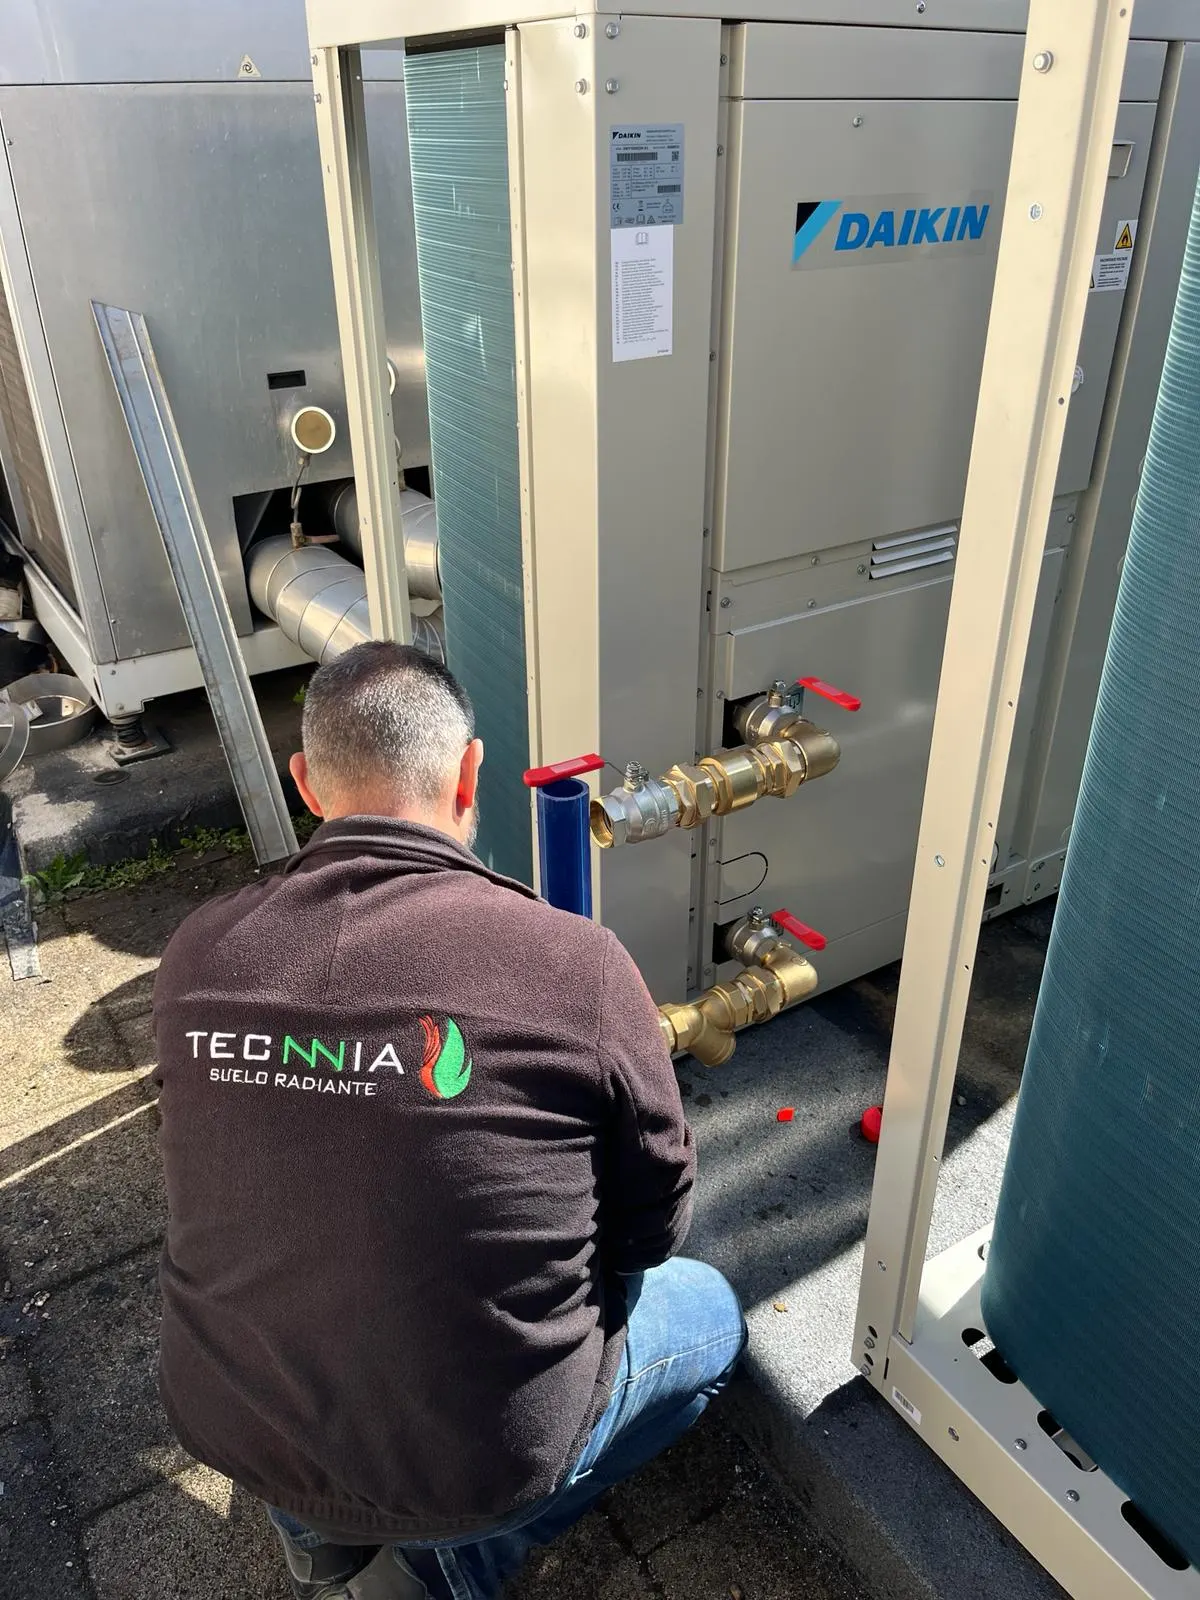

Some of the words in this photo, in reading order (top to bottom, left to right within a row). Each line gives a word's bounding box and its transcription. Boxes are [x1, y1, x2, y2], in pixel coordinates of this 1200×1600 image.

[834, 204, 990, 251] DAIKIN
[209, 1068, 268, 1085] SUELO
[274, 1073, 378, 1096] RADIANTE
